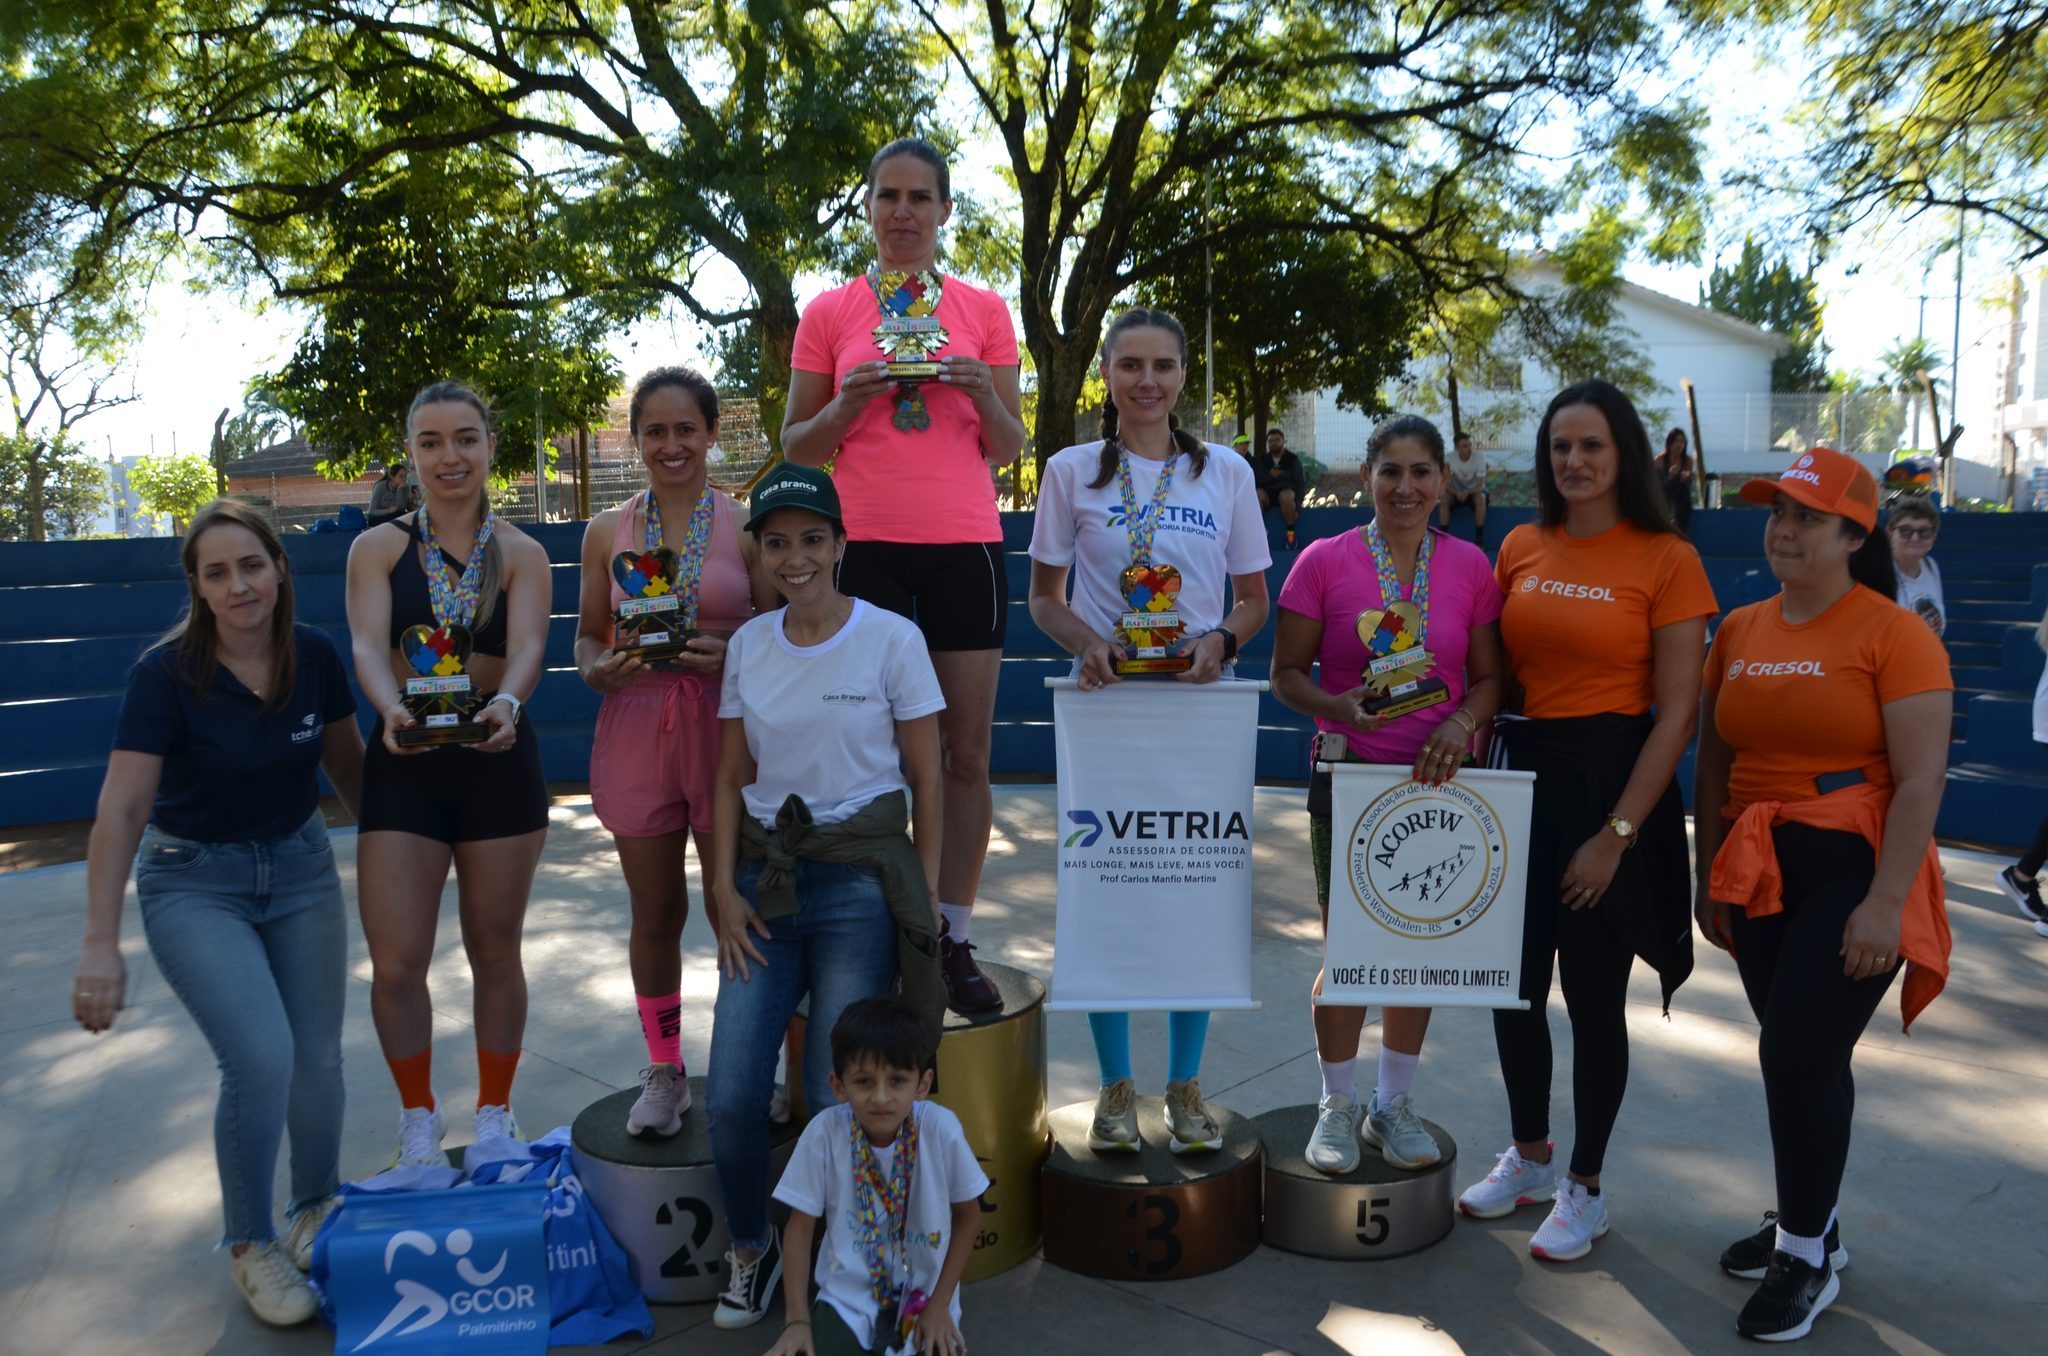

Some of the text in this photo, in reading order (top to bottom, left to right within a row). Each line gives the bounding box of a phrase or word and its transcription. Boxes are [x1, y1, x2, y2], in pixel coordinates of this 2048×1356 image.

[760, 481, 818, 500] Casa Branca
[1181, 526, 1216, 540] ESPORTIVA
[1541, 579, 1616, 602] CRESOL
[623, 601, 678, 614] Autismo
[1125, 617, 1177, 628] Autismo
[1374, 653, 1424, 673] Autismo
[1746, 661, 1826, 676] CRESOL
[410, 681, 469, 693] Autismo
[1362, 791, 1406, 831] Associação
[1407, 784, 1420, 794] de
[1472, 804, 1484, 817] de
[1481, 814, 1495, 835] Rua
[1106, 811, 1249, 840] VETRIA
[1374, 809, 1464, 869] ACORFW
[1108, 846, 1247, 856] ASSESSORIA DE CORRIDA
[1064, 859, 1245, 870] MAIS LONGE, MAIS LEVE, MAIS VOCÊ!
[1100, 874, 1217, 884] Prof Carlos Manfio Martins
[1354, 853, 1372, 900] Frederico
[1466, 866, 1501, 919] Desde 2024
[1332, 964, 1510, 987] VOCÊ É O SEU ÚNICO LIMITE!
[1355, 1198, 1391, 1247] 5
[1125, 1195, 1184, 1275] 3
[450, 1284, 536, 1315] GCOR
[458, 1318, 537, 1337] Palmitinho
